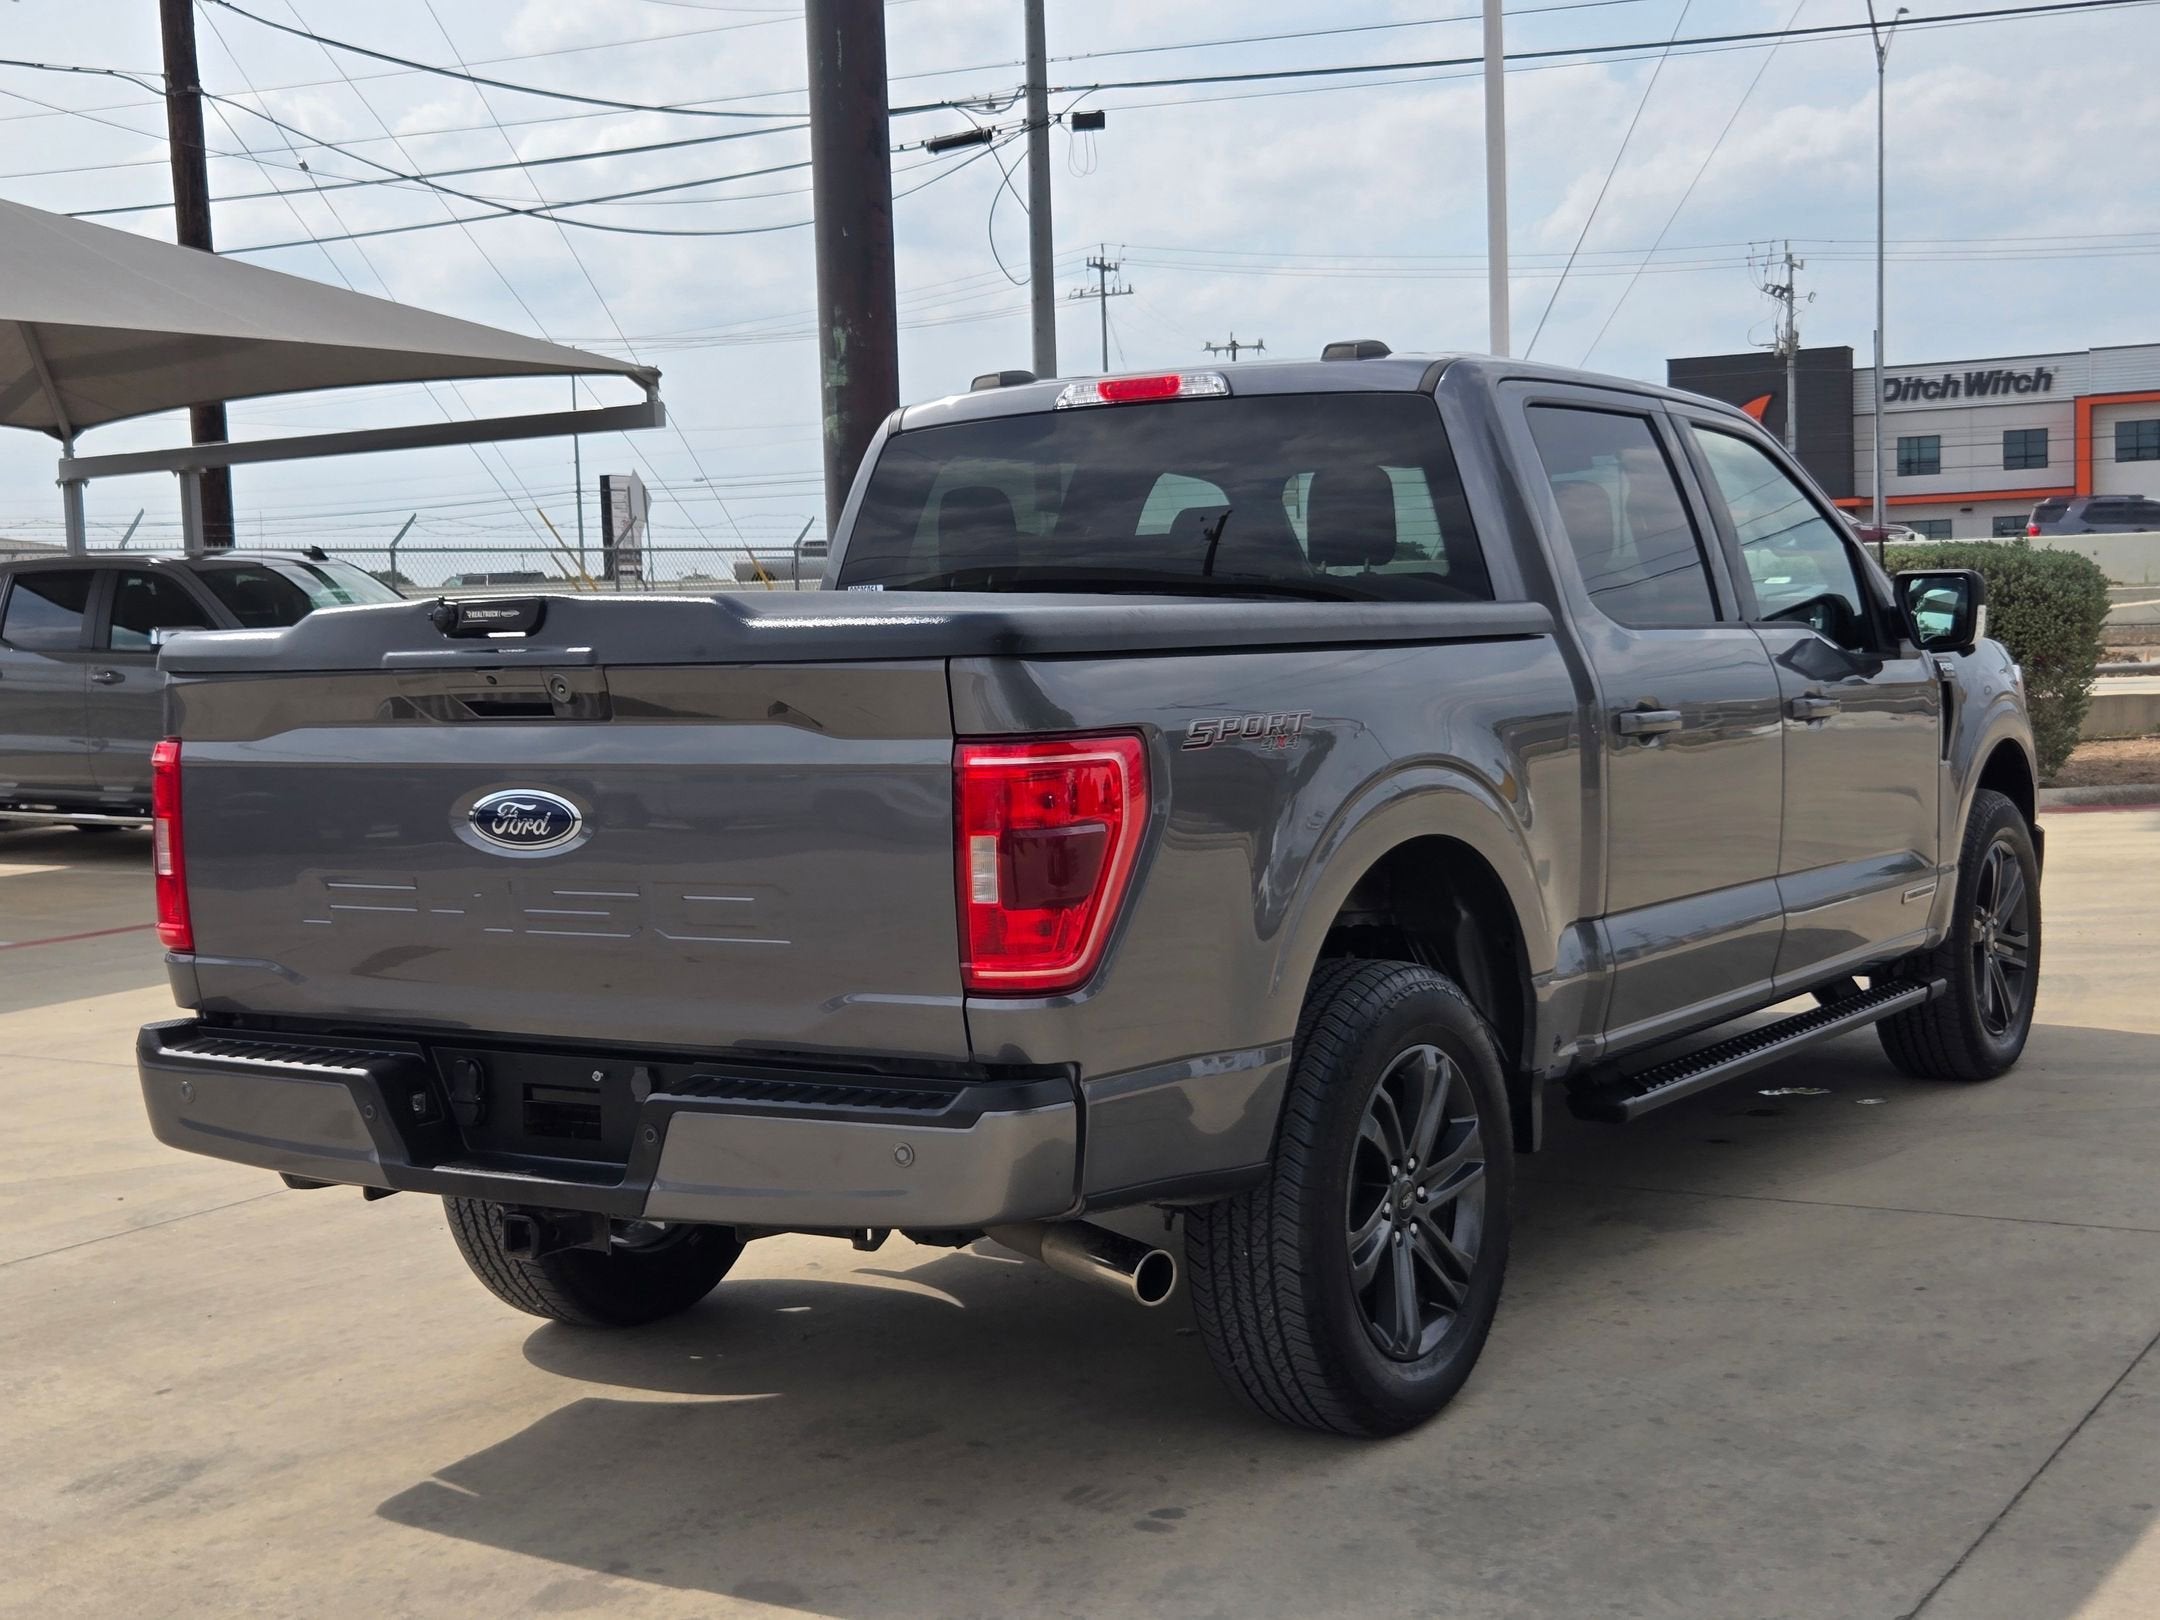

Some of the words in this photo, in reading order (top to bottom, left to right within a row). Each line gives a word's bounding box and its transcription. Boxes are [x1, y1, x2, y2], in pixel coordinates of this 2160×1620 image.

[1883, 374, 1960, 402] Ditch
[1963, 367, 2053, 397] Witch
[1181, 709, 1312, 751] SPORT
[492, 801, 552, 836] Ford
